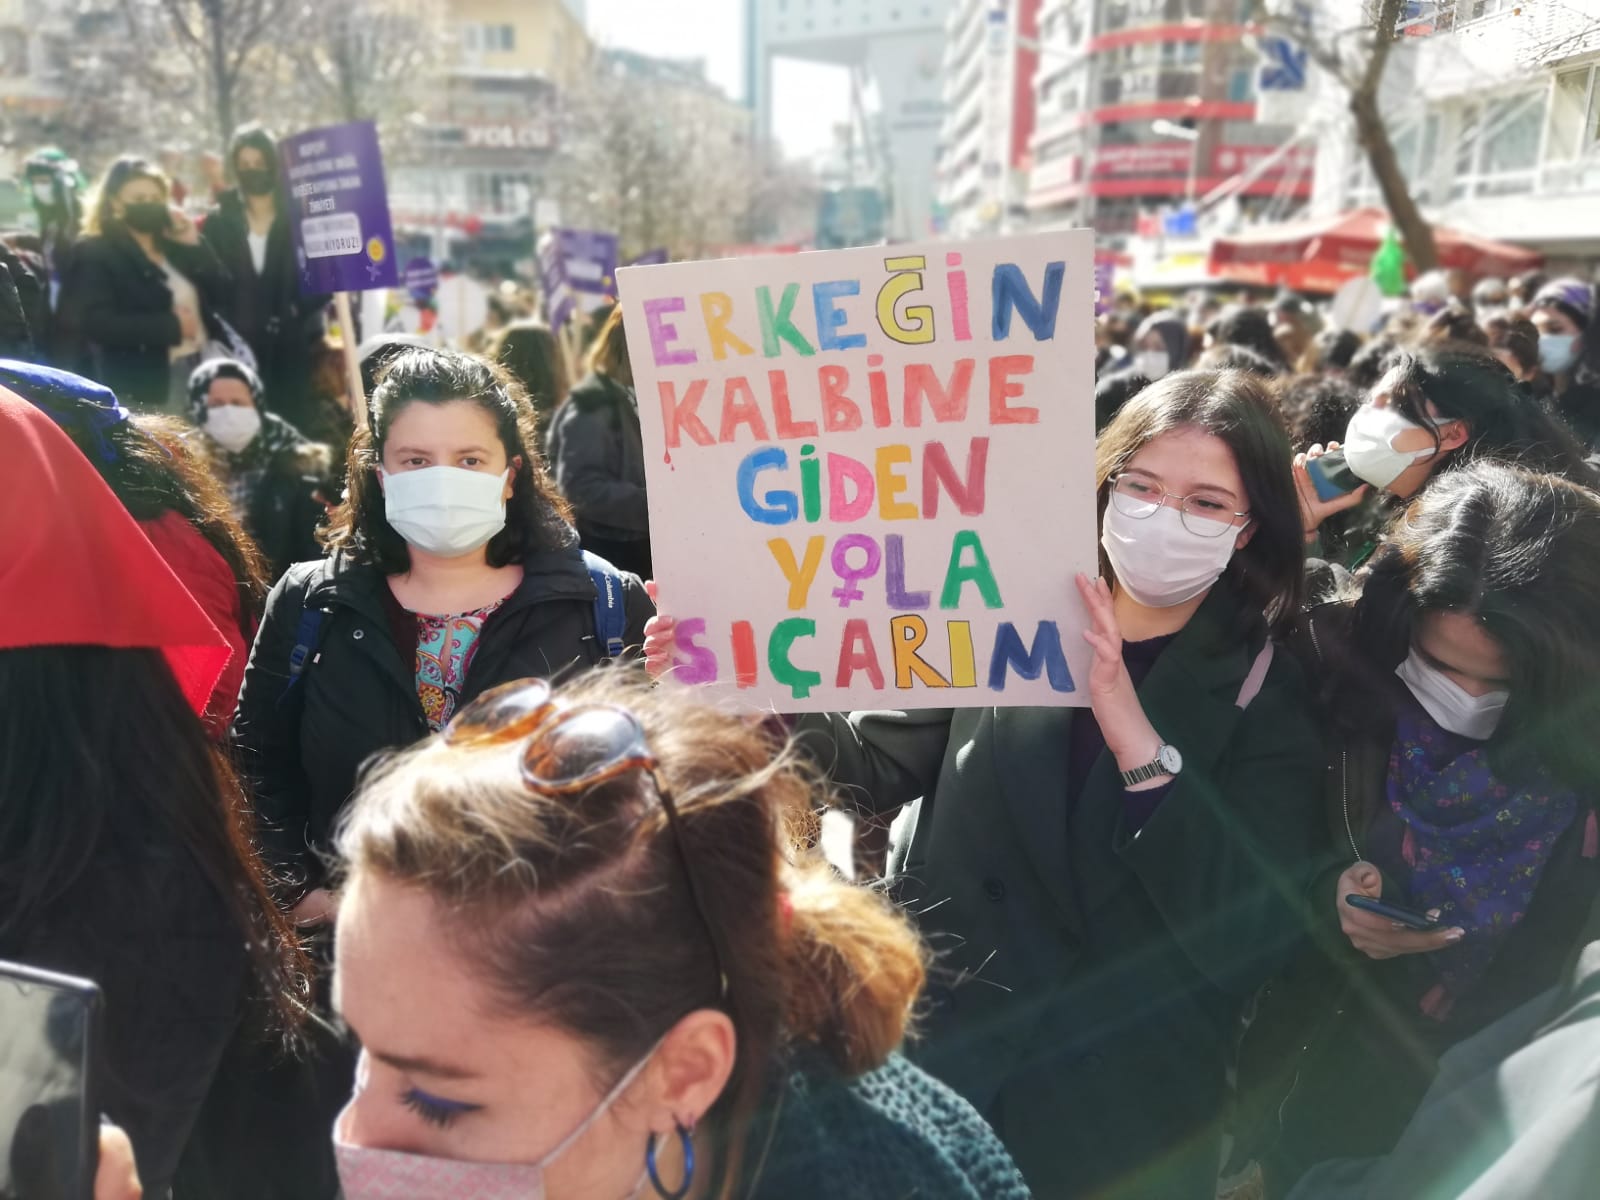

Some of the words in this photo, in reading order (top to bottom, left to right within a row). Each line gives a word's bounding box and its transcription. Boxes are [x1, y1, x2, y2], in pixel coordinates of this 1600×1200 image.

[643, 252, 1066, 366] ERKEĞİN
[657, 354, 1040, 448] KALBİNE
[736, 437, 990, 525] GİDEN
[767, 530, 1004, 610] YOLA
[672, 614, 1076, 699] SIÇARIM
